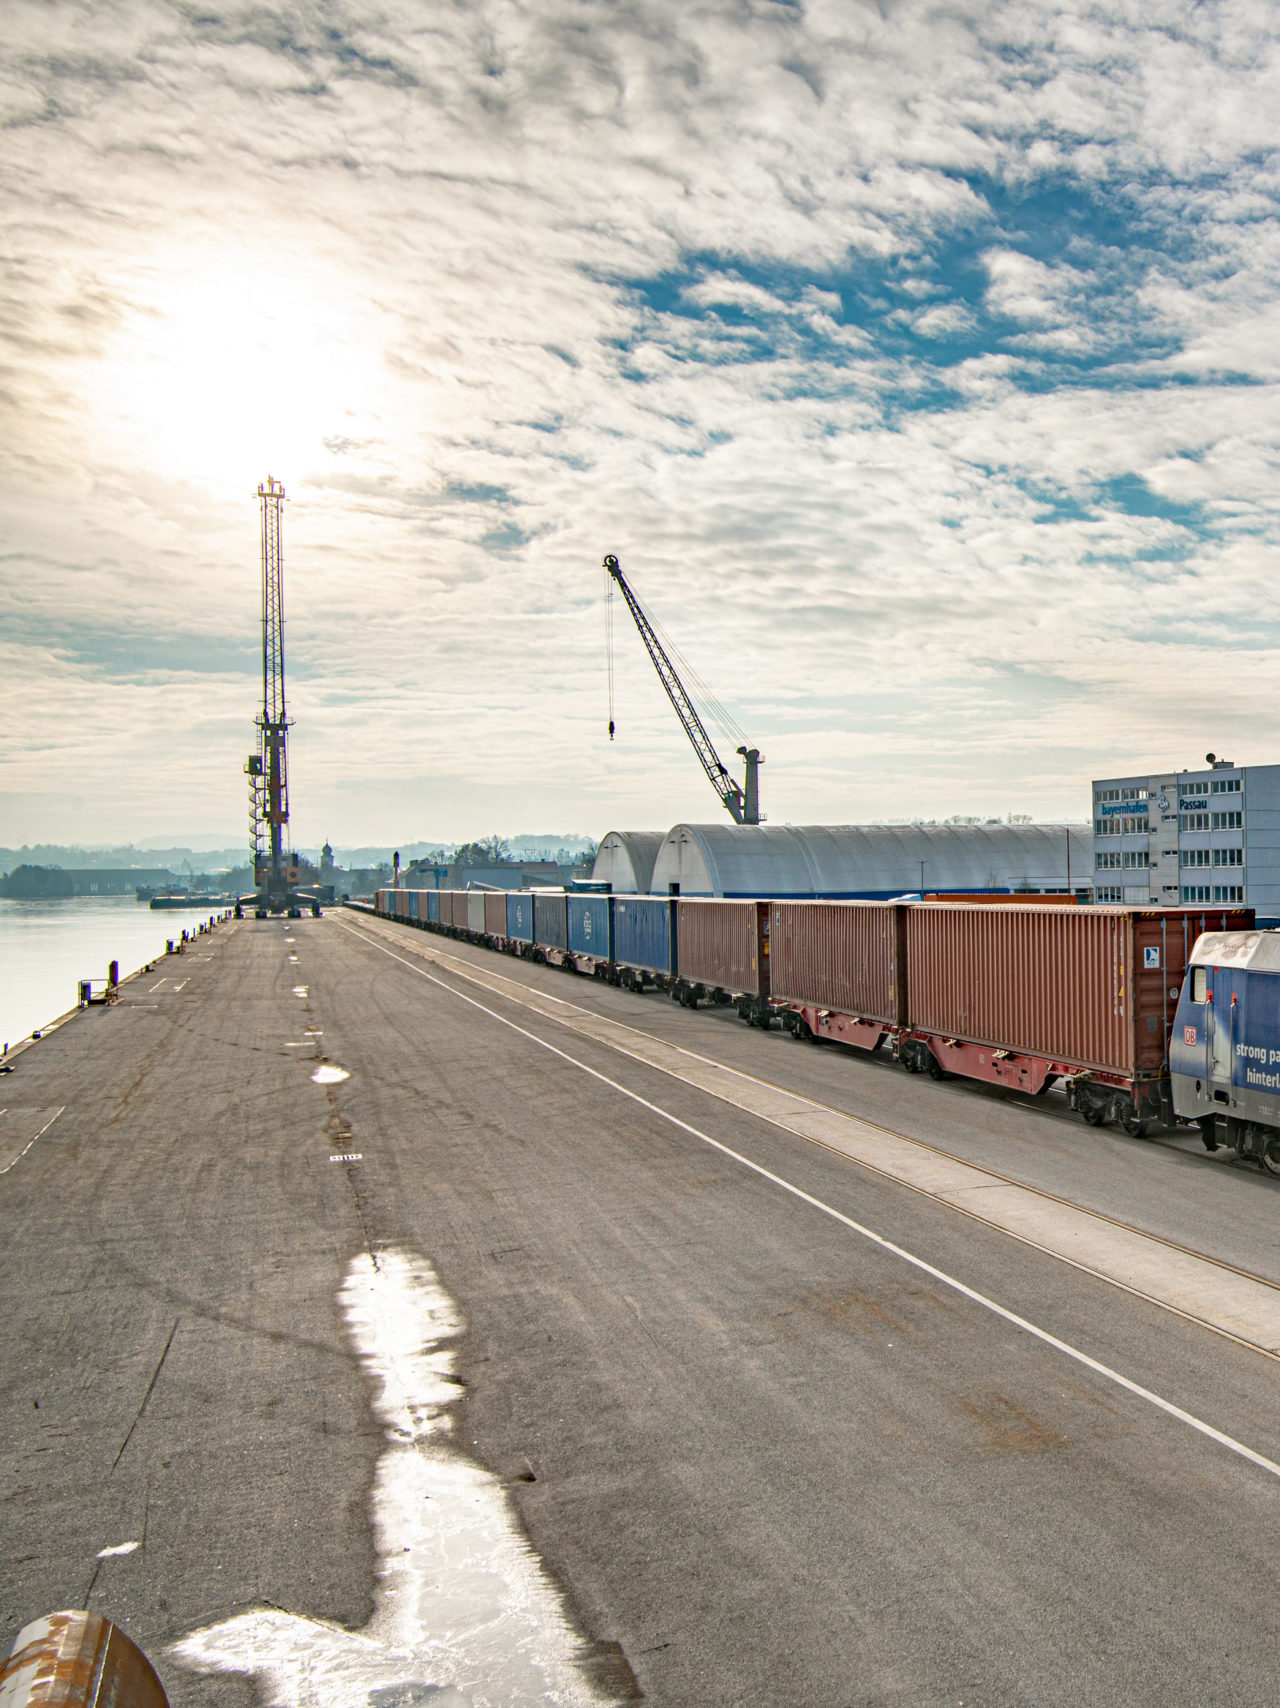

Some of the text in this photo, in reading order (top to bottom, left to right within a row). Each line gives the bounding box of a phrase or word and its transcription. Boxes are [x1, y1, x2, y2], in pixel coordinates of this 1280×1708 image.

[1101, 798, 1207, 818] bayernhafen Passau
[1185, 1029, 1196, 1044] DB
[1236, 1043, 1266, 1064] strong
